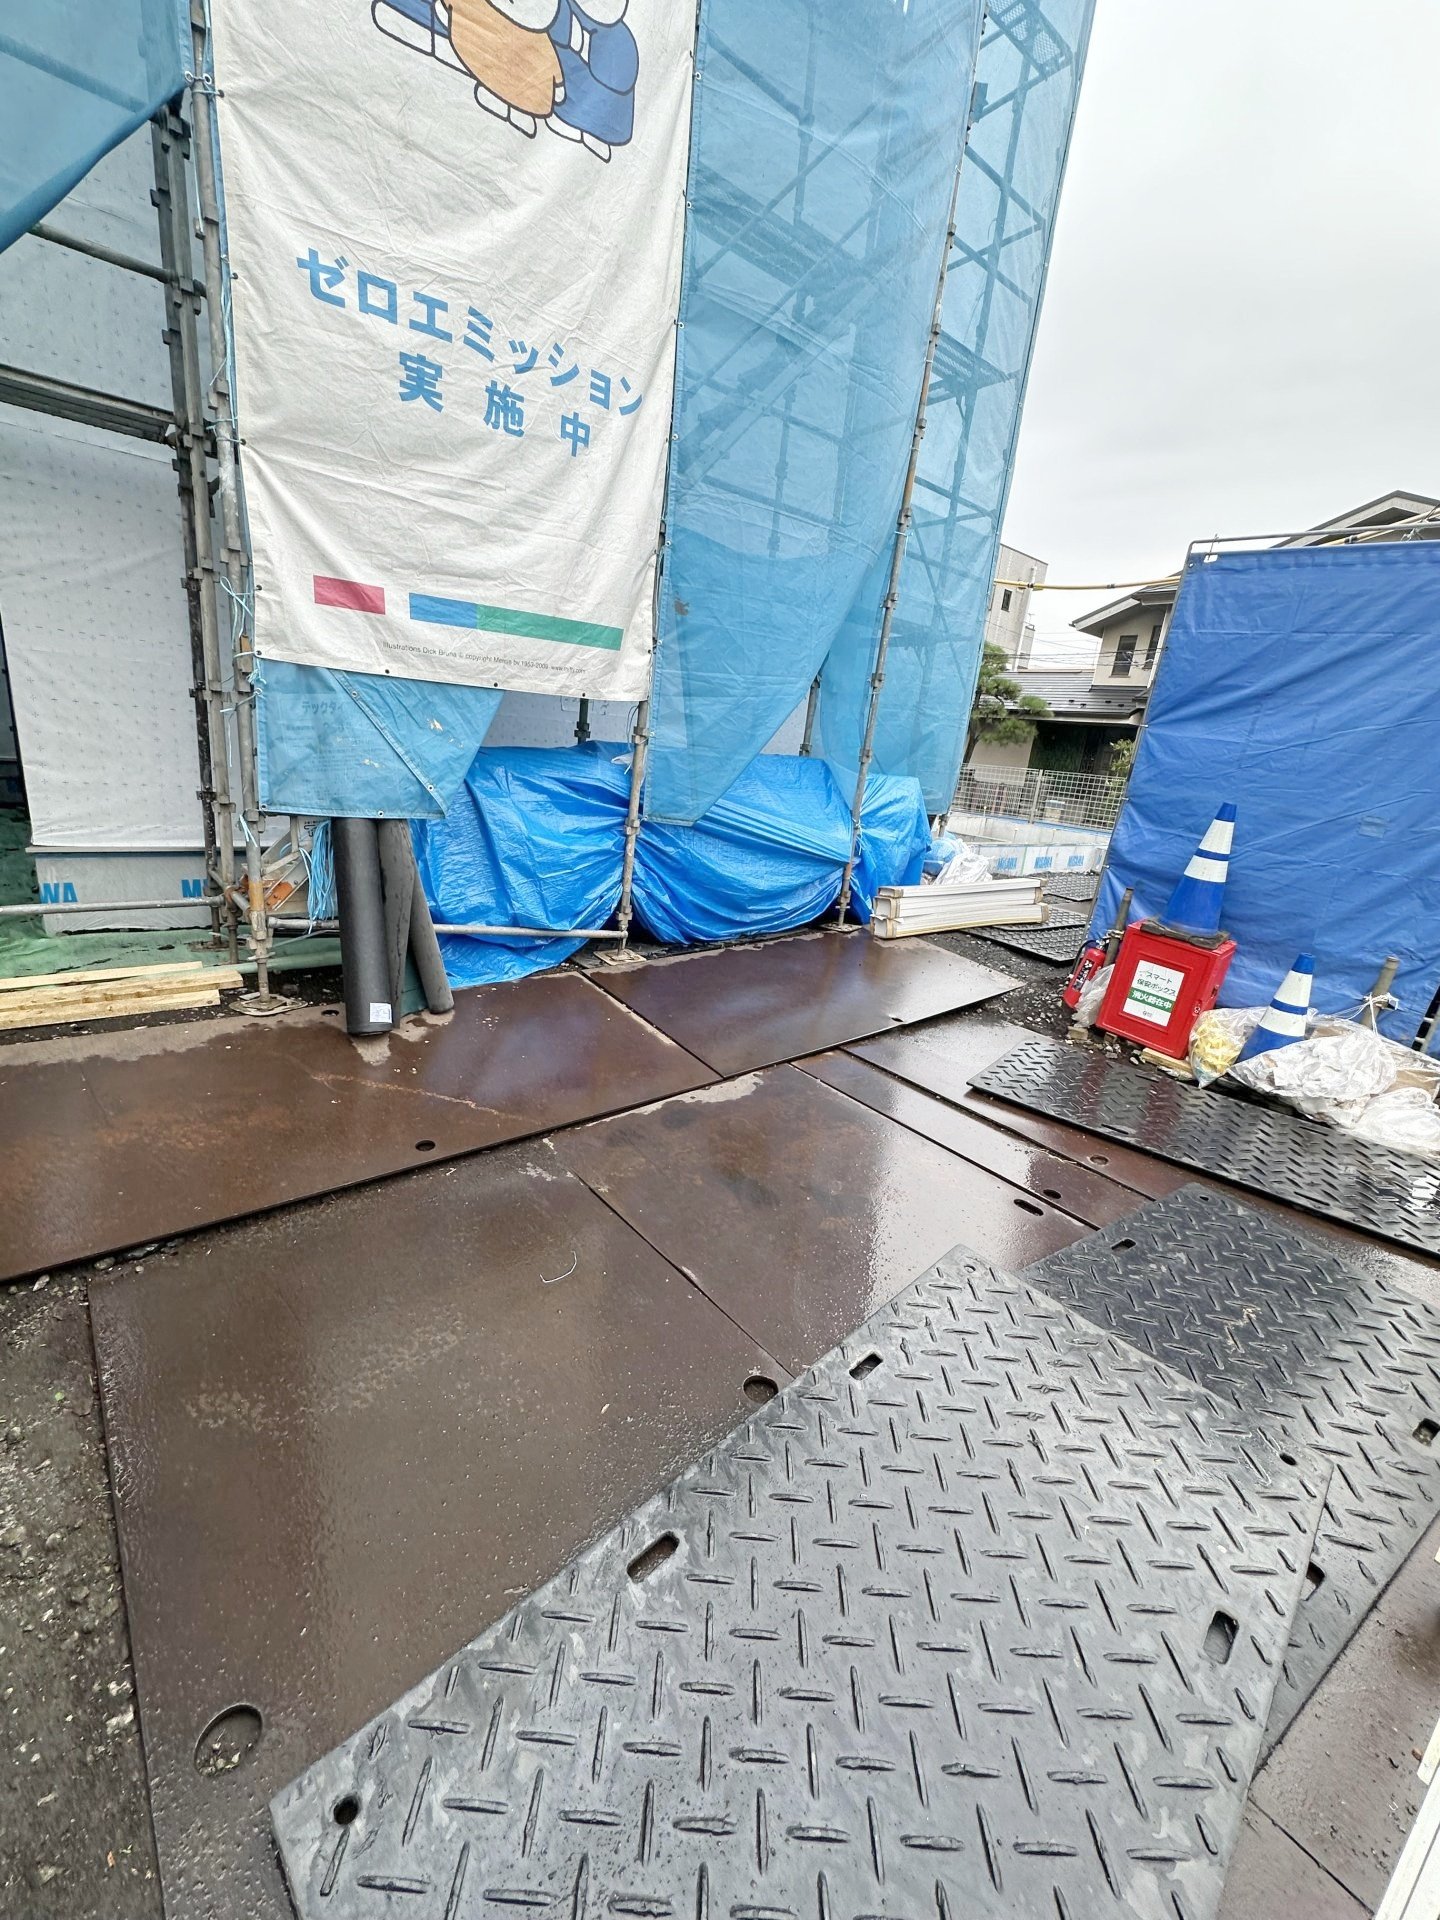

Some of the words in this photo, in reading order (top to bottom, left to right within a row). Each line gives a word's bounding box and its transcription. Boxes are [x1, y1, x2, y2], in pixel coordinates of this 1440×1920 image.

[296, 247, 643, 416] ゼロエミッション
[399, 350, 591, 457] 実施中
[382, 641, 421, 652] Illustrations
[422, 646, 437, 656] Dick
[438, 648, 457, 658] Bruna
[1146, 970, 1173, 984] スマート
